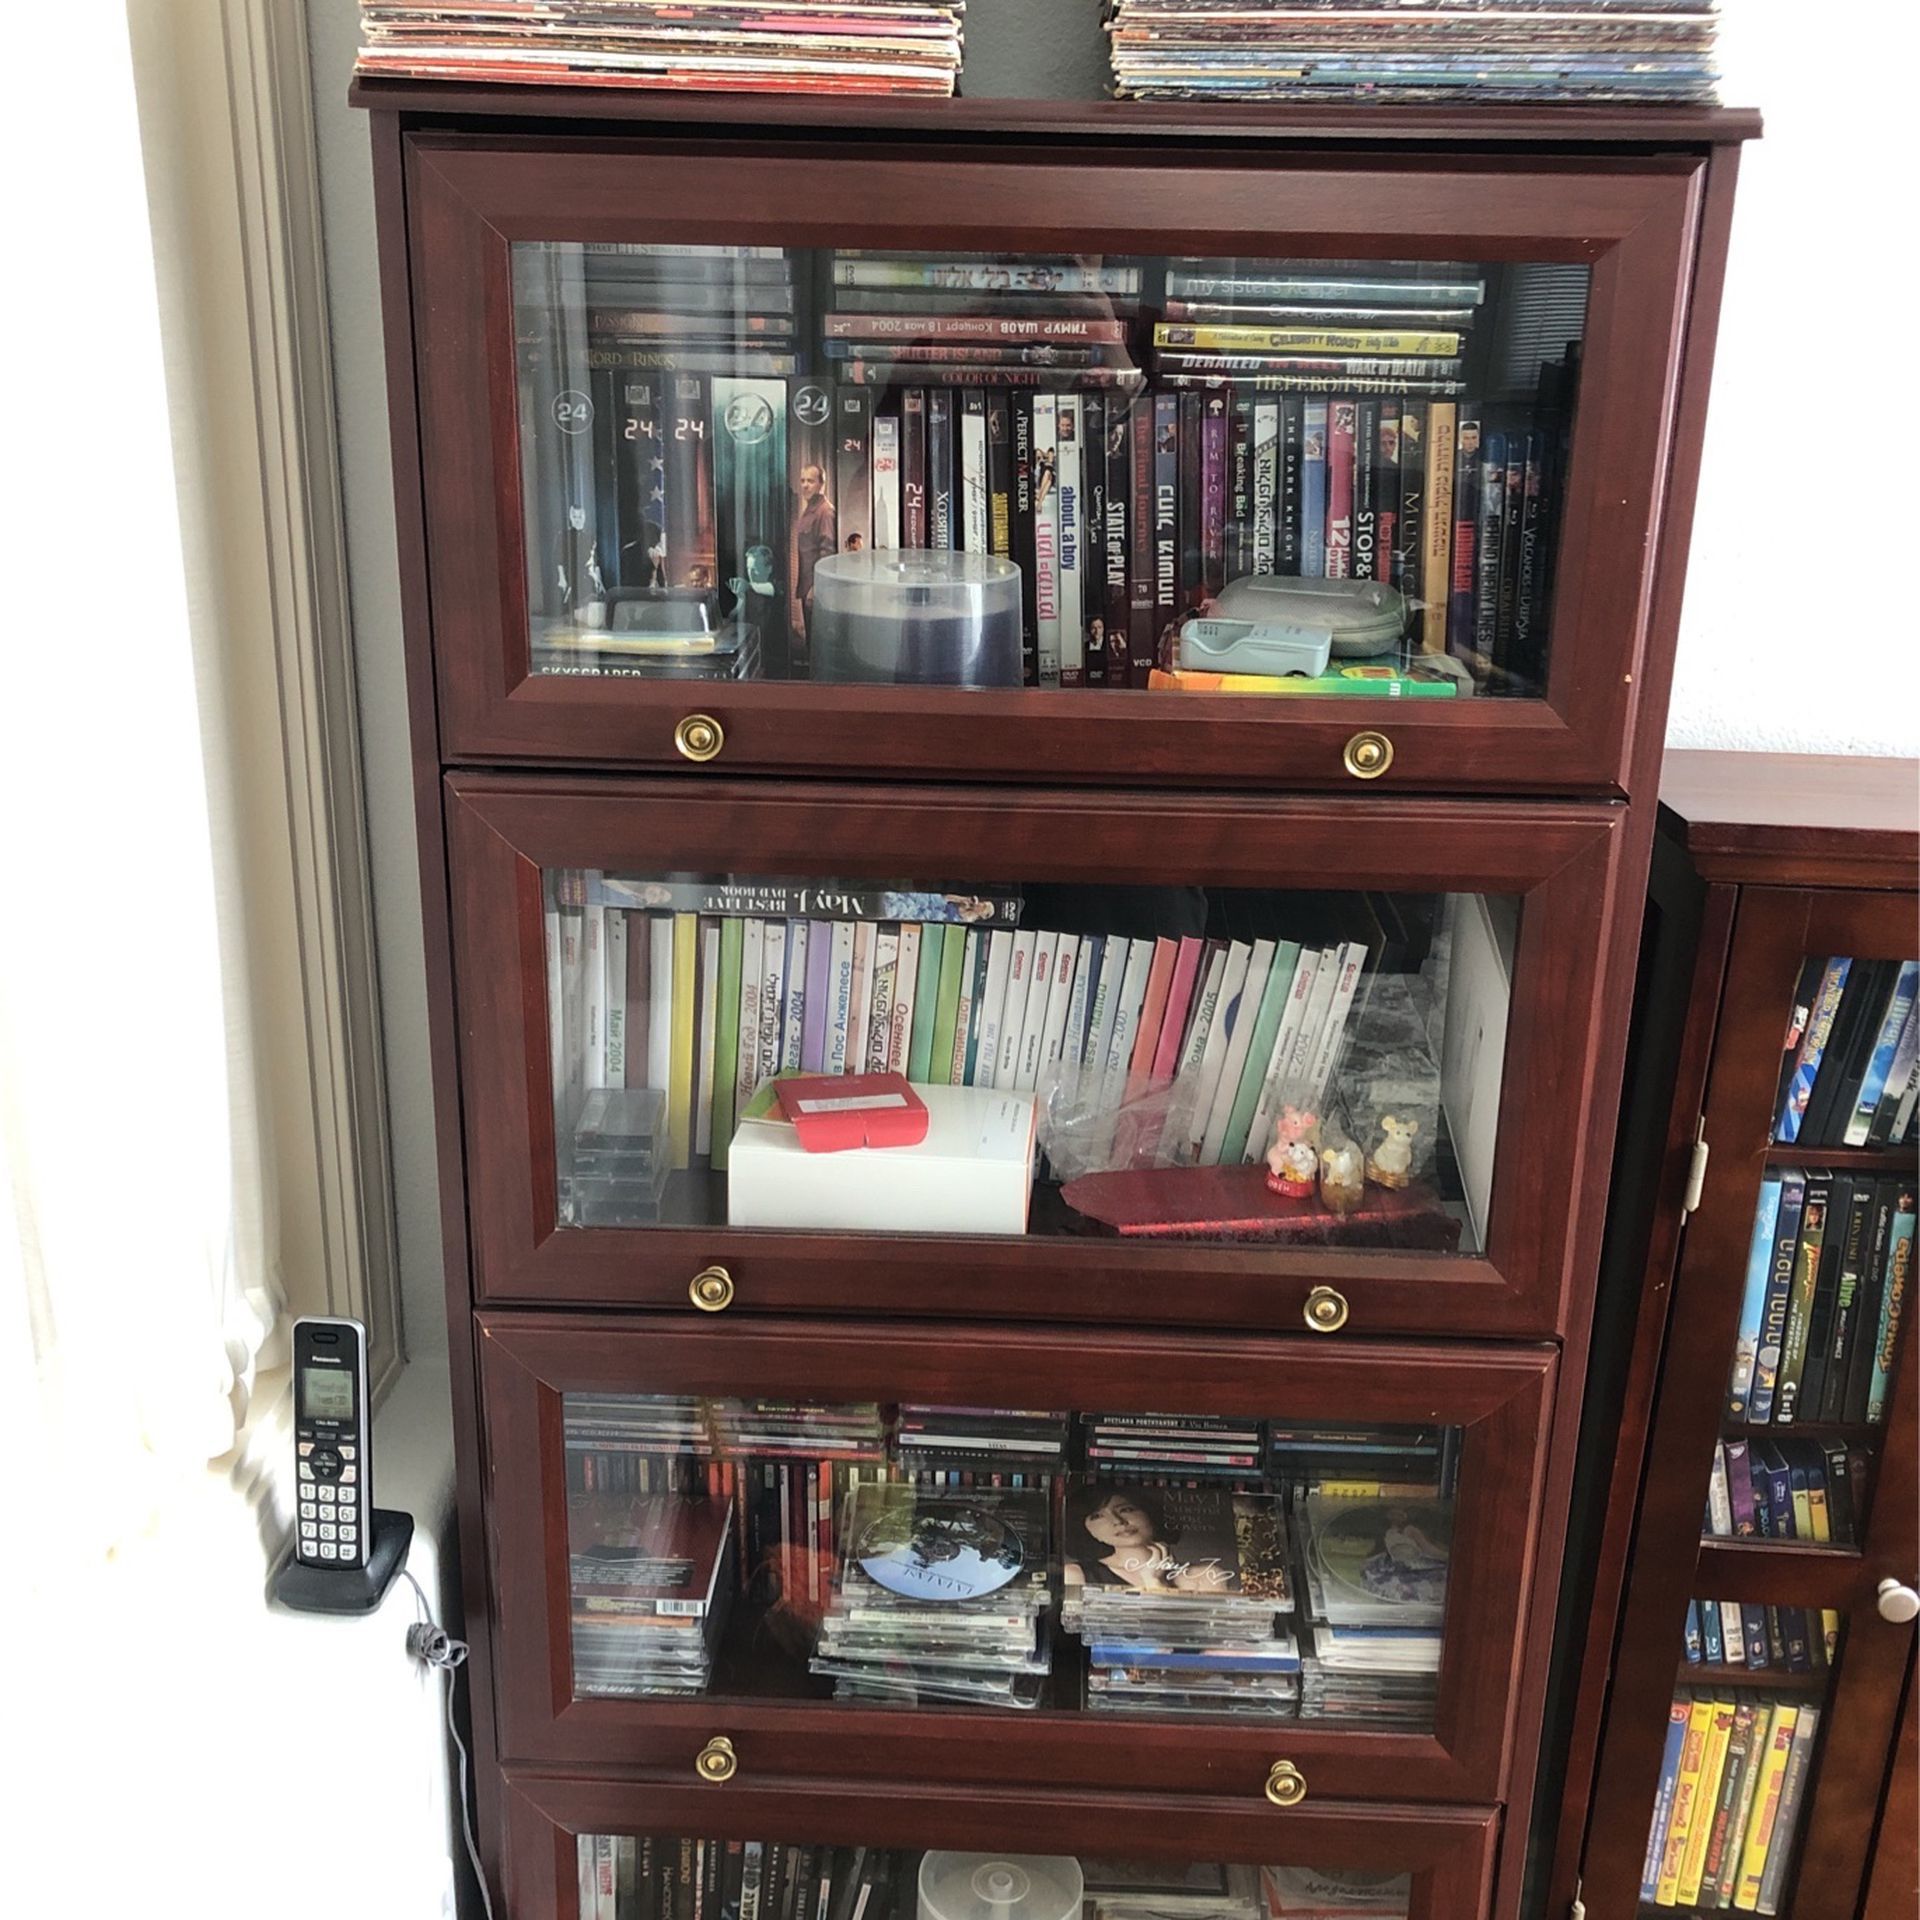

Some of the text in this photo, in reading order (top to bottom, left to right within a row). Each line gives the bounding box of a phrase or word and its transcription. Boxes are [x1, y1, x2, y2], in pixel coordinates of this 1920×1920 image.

[871, 319, 1087, 335] ТИМУР ШАОВ Концерт 18 мая 2004
[1269, 333, 1324, 347] CELEBRITY
[1326, 335, 1361, 348] ROAST
[942, 370, 983, 383] COLOR
[1004, 371, 1041, 384] NIGHT
[1181, 357, 1262, 370] DERAILED
[1346, 360, 1379, 375] WAKE
[1391, 361, 1427, 377] DEATH
[557, 402, 588, 421] 24
[727, 404, 772, 432] 24
[796, 395, 829, 416] 24
[624, 419, 653, 440] 24
[674, 419, 705, 440] 24
[844, 438, 862, 452] 24
[1016, 408, 1029, 513] A PERFECT MURDER
[906, 482, 923, 508] 24
[1134, 414, 1152, 555] The Final Journey
[1234, 442, 1248, 518] Breaking Bad
[1285, 416, 1296, 561] THE DARK KNIGHT
[1106, 502, 1125, 541] STATE
[1157, 484, 1175, 531] כחול
[1060, 486, 1078, 571] about a boy
[1255, 508, 1271, 548] צילום
[1331, 515, 1351, 546] 12
[1107, 555, 1126, 587] PLAY
[1478, 515, 1501, 642] BEHIND ENEMY LINES
[1132, 658, 1152, 667] VCD
[702, 897, 786, 912] BEST LIVE
[718, 886, 786, 899] DVD BOOK
[810, 889, 864, 917] May
[1058, 953, 1072, 984] Costco
[744, 983, 758, 1016] 2004
[789, 989, 804, 1023] 2004
[834, 960, 851, 1031] Анжелесе
[959, 995, 971, 1024] шоу
[1200, 991, 1218, 1026] 2005
[609, 1009, 623, 1073] Май 2004
[831, 1034, 845, 1062] Лос
[890, 1003, 908, 1067] Осеннее
[1838, 1272, 1858, 1308] Alive
